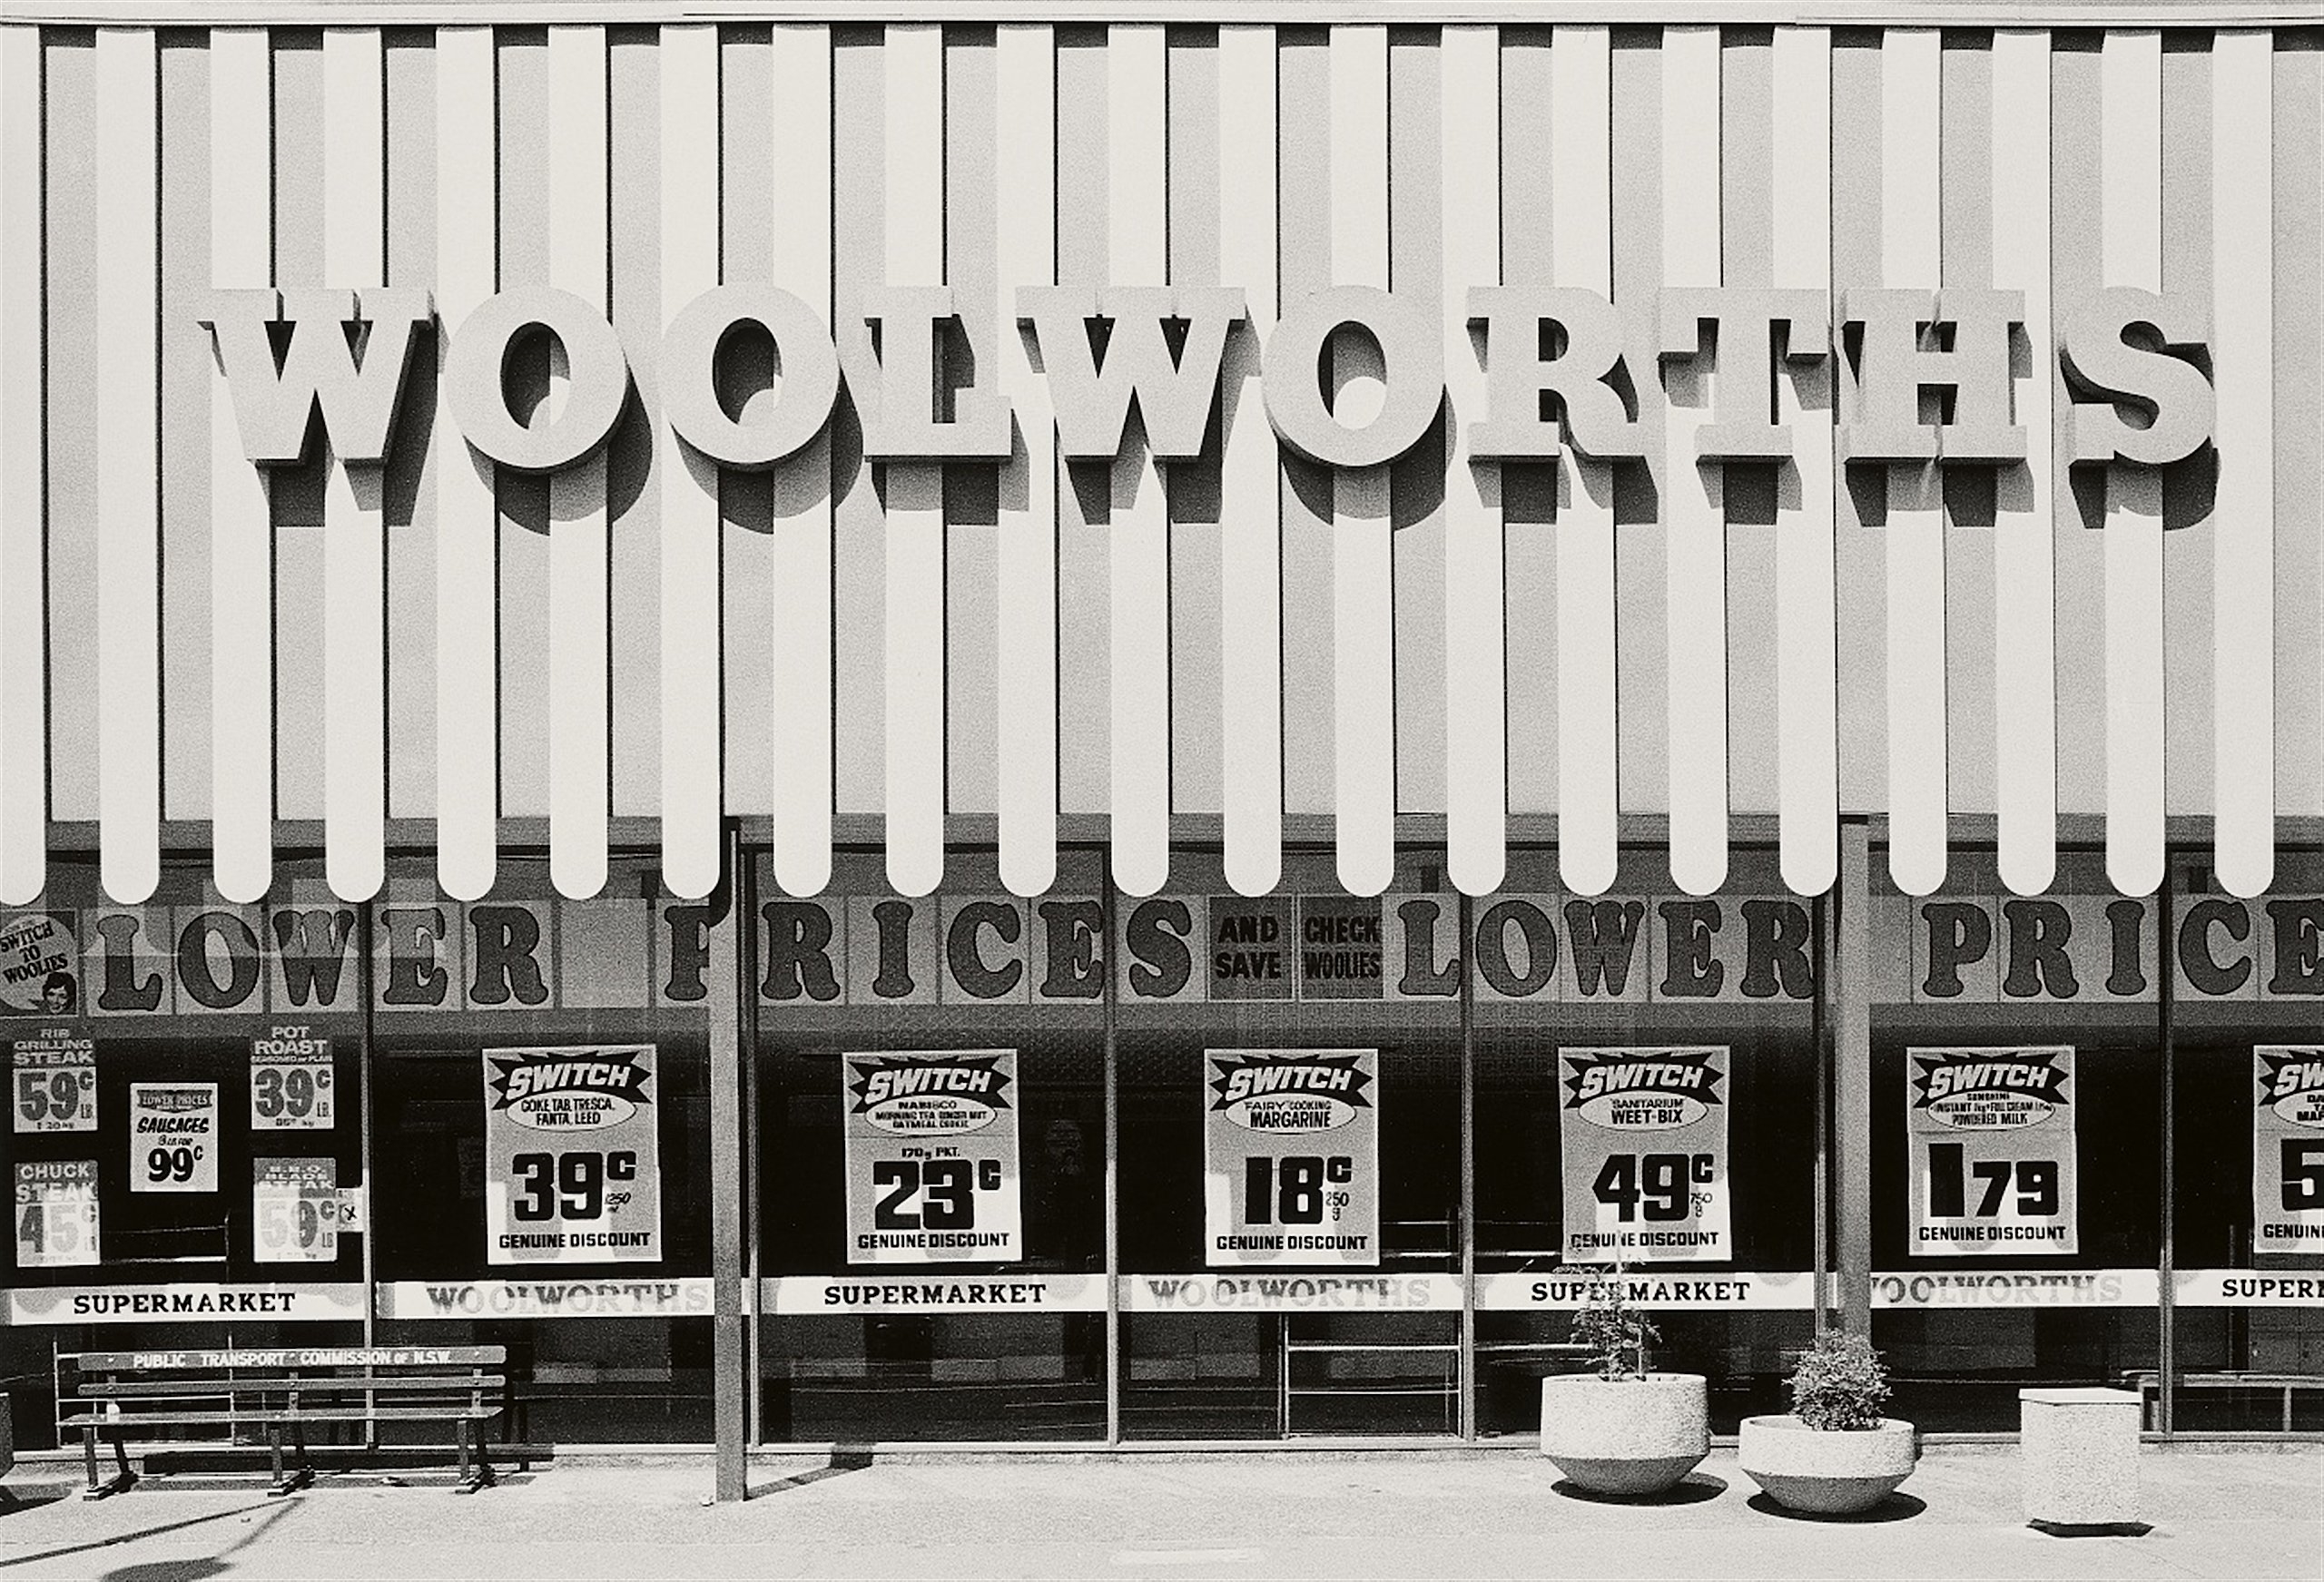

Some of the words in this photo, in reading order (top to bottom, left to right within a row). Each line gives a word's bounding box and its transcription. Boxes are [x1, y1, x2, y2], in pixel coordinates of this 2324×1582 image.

[198, 285, 2217, 472] WOOLWORTHS
[0, 921, 54, 952] SWITCH
[1218, 917, 1279, 943] AND
[1305, 917, 1381, 943] CHECK
[19, 945, 41, 962] TO
[1398, 900, 1816, 998] LOWER
[1922, 899, 2324, 997] PRICE
[97, 907, 548, 1010] LOWER
[1216, 953, 1281, 978] SAVE
[1305, 953, 1380, 978] WOOLIES
[3, 953, 68, 984] WOOLIES
[41, 1028, 70, 1038] RIB
[272, 1027, 310, 1038] POT
[14, 1039, 94, 1050] GRILLING
[255, 1039, 327, 1054] ROAST
[13, 1051, 95, 1064] STEAK
[506, 1063, 631, 1100] SWITCH
[864, 1067, 991, 1105] SWITCH
[1226, 1066, 1353, 1101] SWITCH
[1580, 1063, 1704, 1099] SWITCH
[1928, 1064, 2050, 1099] SWITCH
[521, 1099, 549, 1112] COKE
[137, 1116, 209, 1133] SAUSAGES
[1250, 1111, 1331, 1127] MARGARINE
[1611, 1109, 1684, 1125] WEET-BIX
[2001, 1113, 2028, 1125] MILK
[21, 1164, 89, 1179] CHUCK
[16, 1182, 94, 1202] STEAK
[1326, 1192, 1349, 1207] 250
[1640, 1232, 1719, 1246] DISCOUNT
[1919, 1227, 1984, 1241] GENUINE
[1987, 1226, 2066, 1240] DISCOUNT
[2263, 1223, 2324, 1238] GENUIN
[499, 1233, 566, 1249] GENUINE
[570, 1232, 650, 1247] DISCOUNT
[858, 1234, 926, 1249] GENUINE
[929, 1233, 1009, 1247] DISCOUNT
[1216, 1236, 1284, 1250] GENUINE
[1287, 1235, 1368, 1250] DISCOUNT
[427, 1283, 709, 1315] WOOLWORTHS
[824, 1284, 1046, 1305] SUPERMARKET
[1148, 1278, 1431, 1308] WOOLWORTHS
[74, 1292, 295, 1314] SUPERMARKET
[133, 1353, 186, 1369] PUBLIC
[200, 1352, 286, 1368] TRANSPORT
[300, 1351, 391, 1366] COMMISSION
